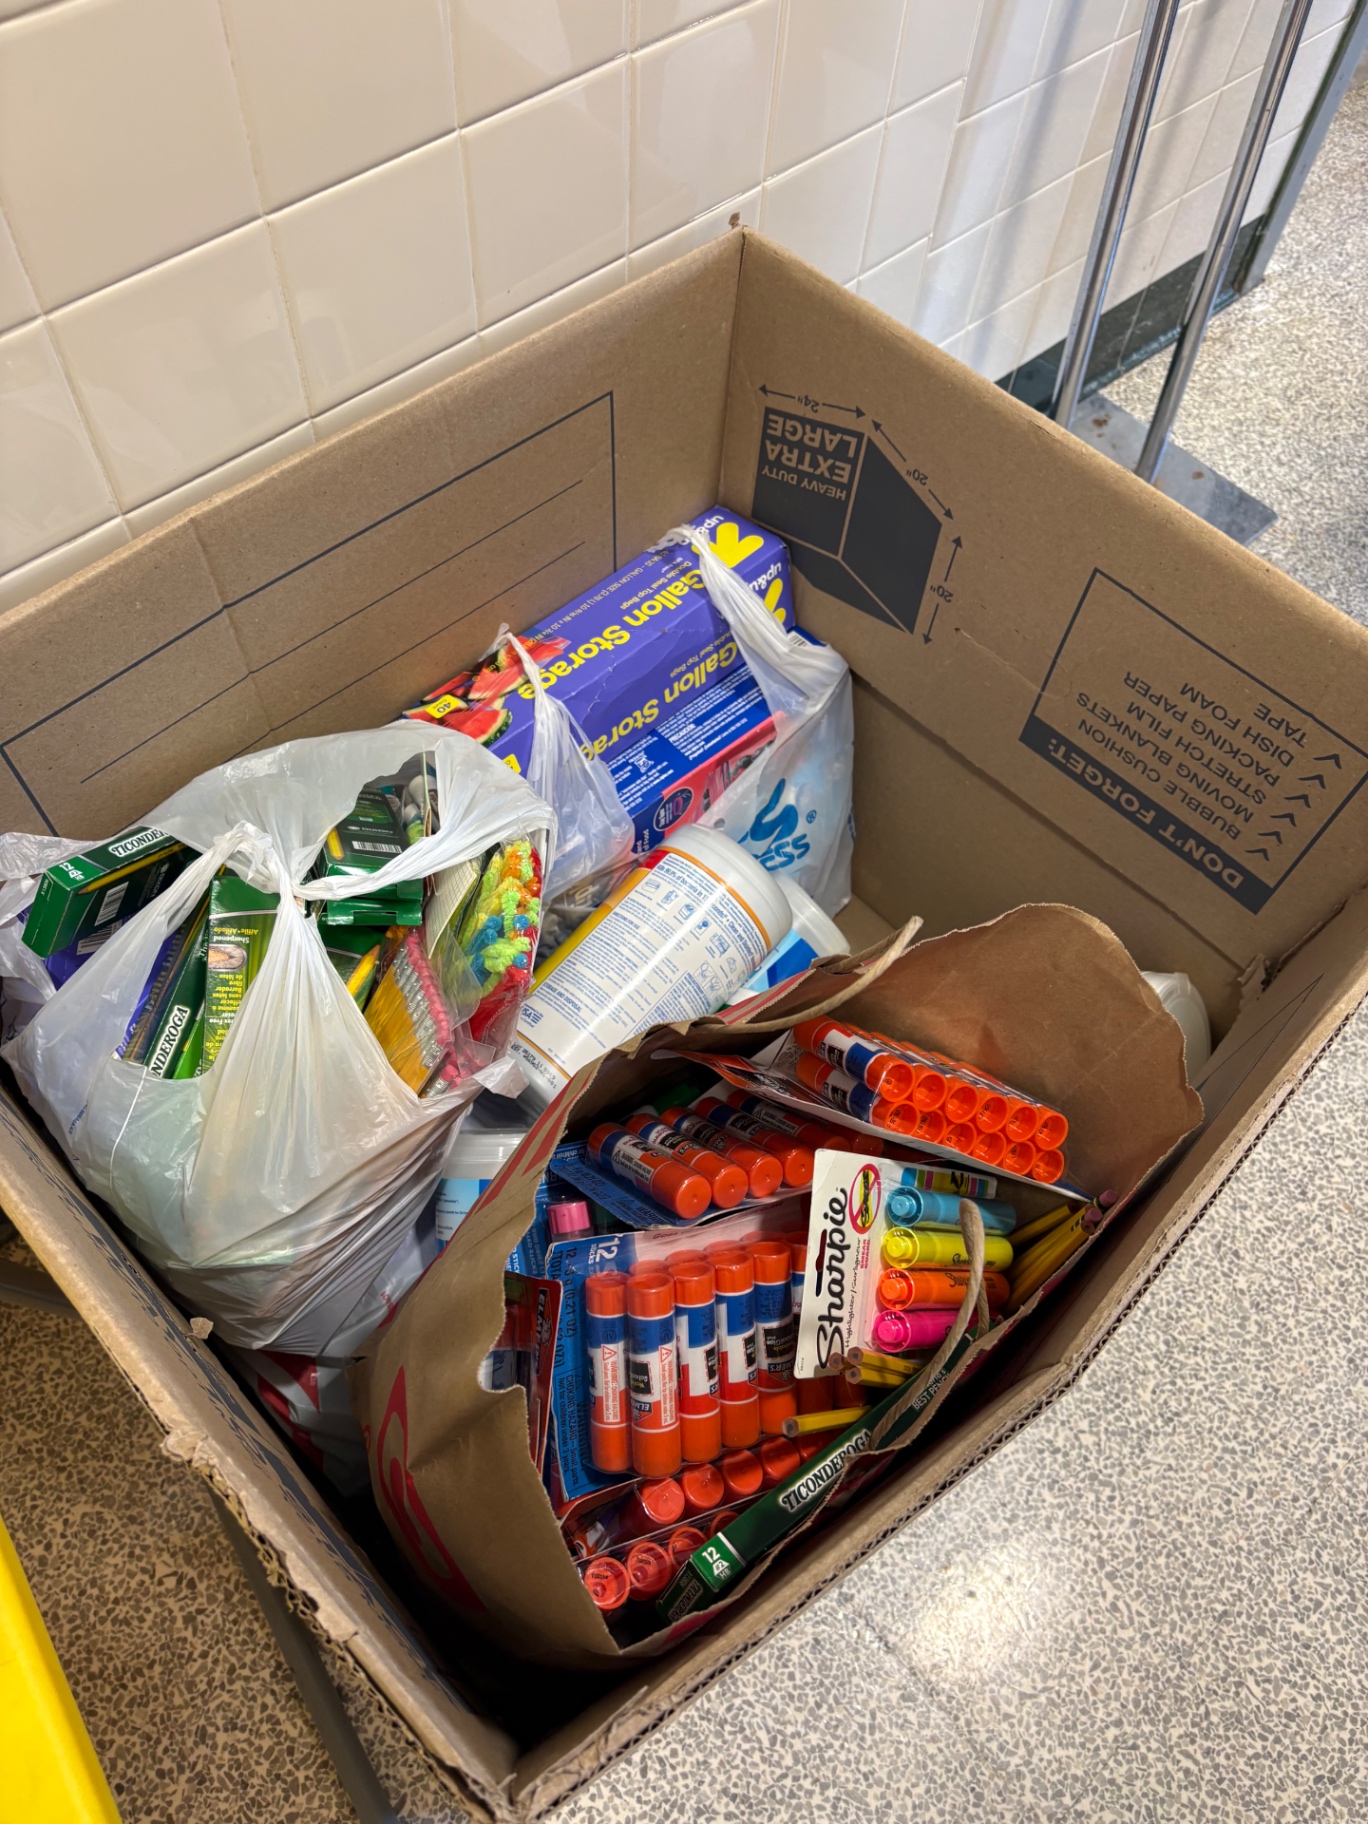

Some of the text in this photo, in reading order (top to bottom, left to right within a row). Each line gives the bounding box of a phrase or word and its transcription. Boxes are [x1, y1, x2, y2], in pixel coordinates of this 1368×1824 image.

[796, 394, 820, 412] 24"
[765, 414, 858, 456] LARGE
[762, 439, 851, 483] EXTRA
[905, 468, 928, 485] 20"
[761, 465, 846, 499] HEAVY DUTY
[619, 558, 691, 611] Double Seal Top Bags
[622, 564, 708, 634] Gallon
[930, 585, 953, 603] 20"
[712, 629, 734, 647] ouble
[513, 617, 628, 707] Storage
[663, 640, 734, 706] Gallon
[436, 700, 453, 715] 40
[1121, 670, 1280, 788] PACKING PAPER
[1178, 681, 1295, 768] DISH FOAM
[1252, 700, 1310, 748] TAPE
[1073, 690, 1254, 824] MOVING BLANKETS
[1124, 700, 1267, 806] STRETCH FILM
[1076, 717, 1241, 840] BUBBLE CUSHION
[1044, 737, 1245, 888] DON'T FORGET:
[58, 861, 74, 871] 12
[542, 981, 582, 1012] STORAGE AND DISPOSAL
[148, 1005, 188, 1075] NDEROGA
[565, 1247, 577, 1260] 12
[587, 1243, 597, 1264] sticks
[595, 1236, 618, 1262] 12
[817, 1187, 850, 1367] Sharpie
[565, 1319, 575, 1338] OZ)
[559, 1403, 567, 1427] children
[911, 1390, 931, 1410] BEST
[565, 1374, 574, 1407] CHOKING
[570, 1469, 578, 1485] parts.
[561, 1454, 569, 1473] years.
[701, 1544, 720, 1563] 12
[713, 1560, 724, 1571] #2
[718, 1567, 731, 1579] HB
